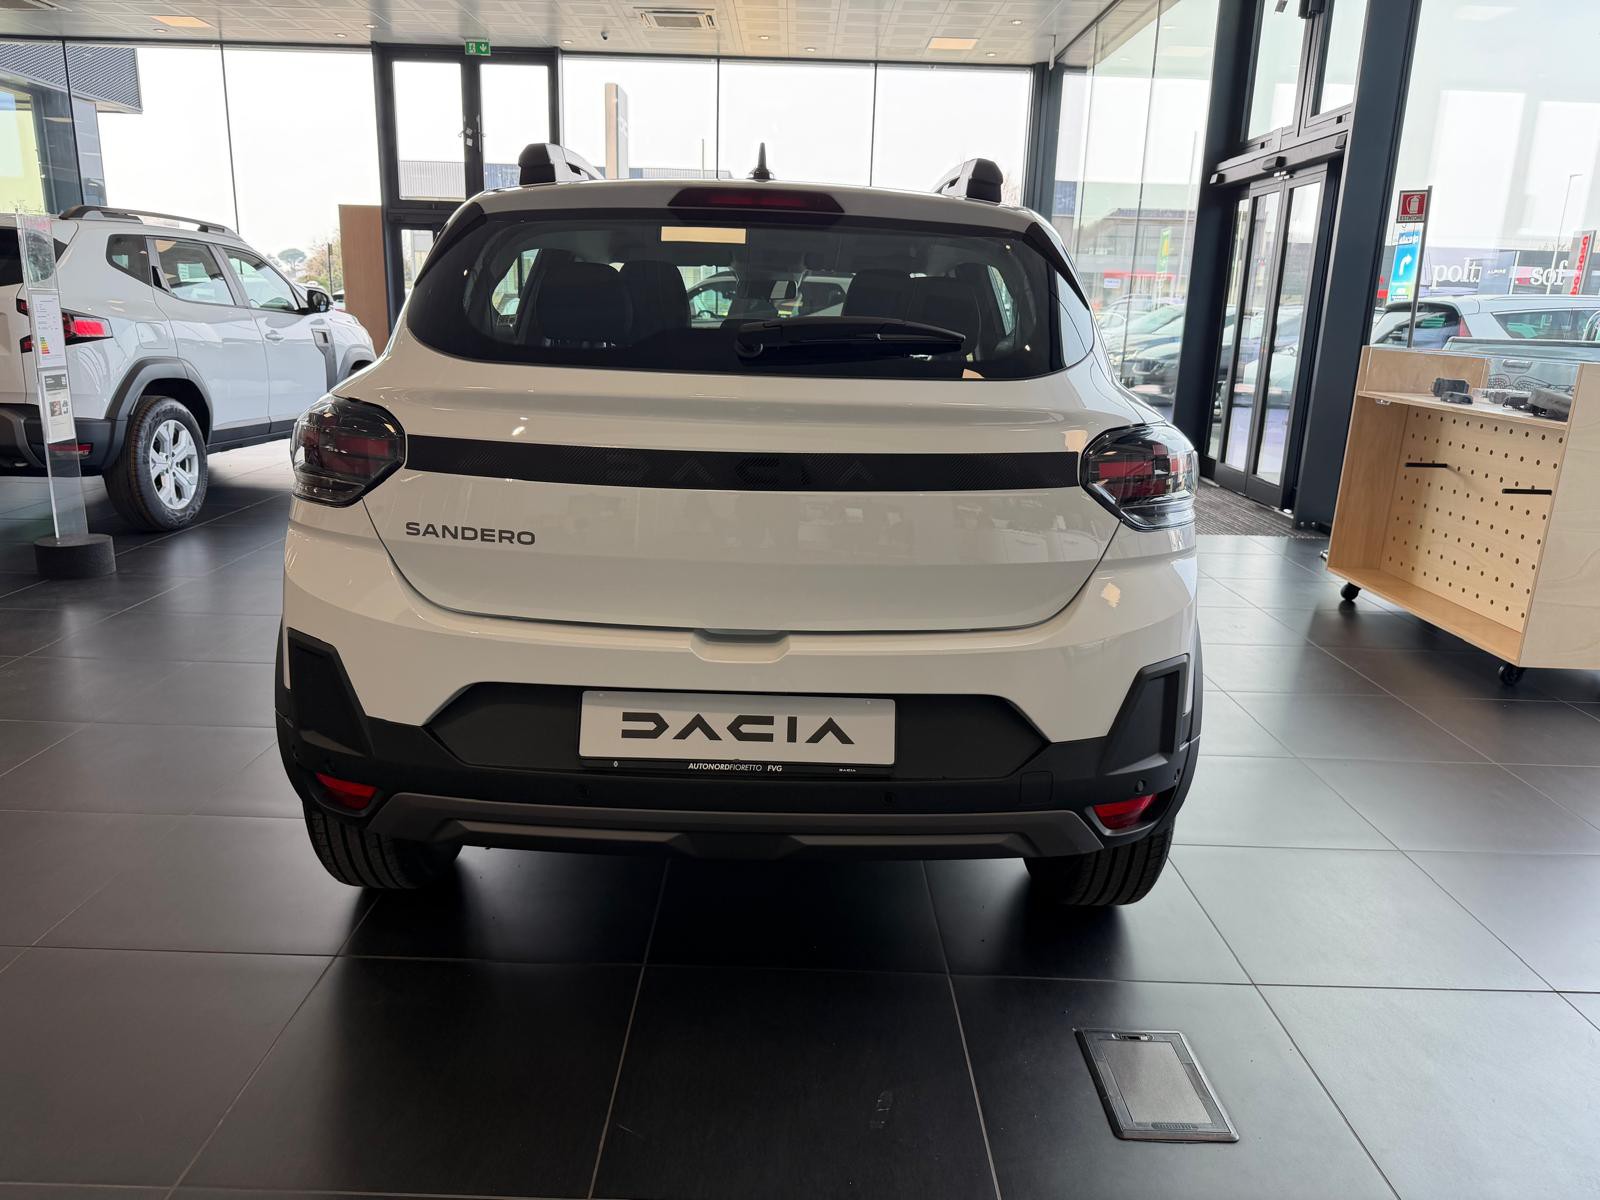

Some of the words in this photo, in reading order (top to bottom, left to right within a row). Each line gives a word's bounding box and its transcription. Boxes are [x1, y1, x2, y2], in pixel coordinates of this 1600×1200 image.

[405, 521, 536, 546] SANDERO
[620, 711, 856, 745] DACIA
[767, 764, 783, 772] FVG
